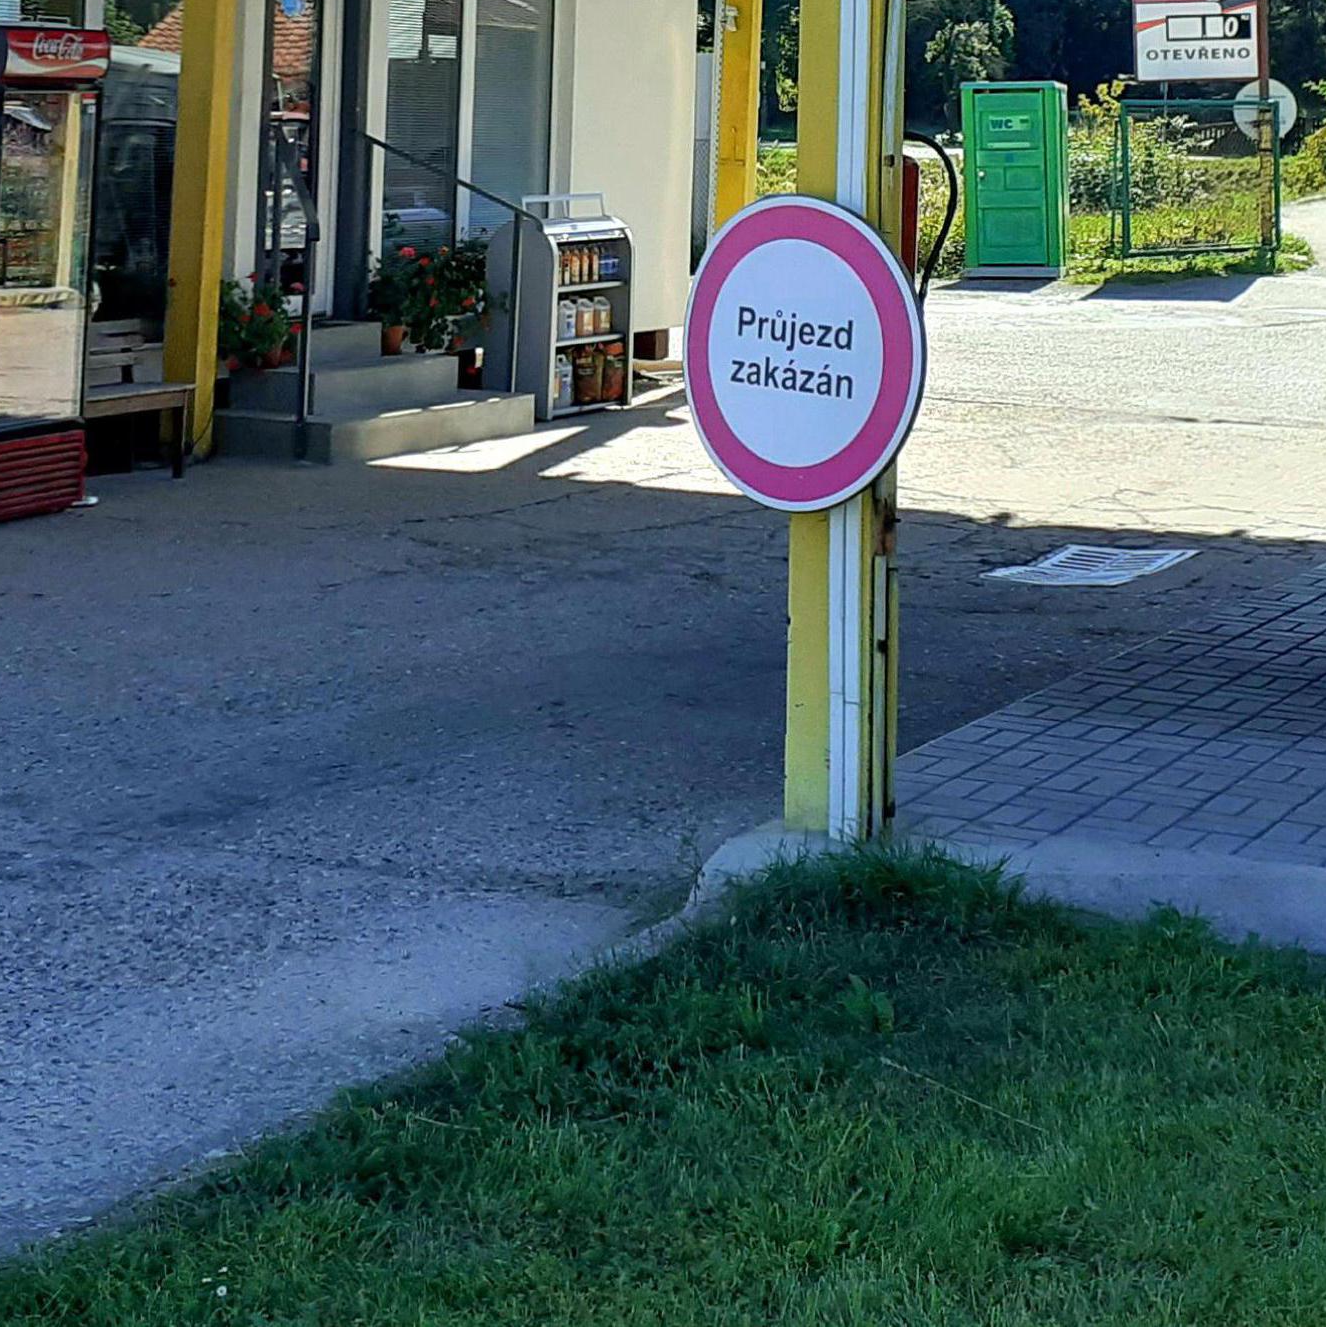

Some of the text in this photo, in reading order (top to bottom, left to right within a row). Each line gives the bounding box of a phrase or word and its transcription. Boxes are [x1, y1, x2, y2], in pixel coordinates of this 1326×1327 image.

[33, 32, 83, 60] Coca-Cola
[1146, 46, 1251, 61] OTEVŘENO
[990, 118, 1013, 130] WC
[737, 306, 854, 352] Průjezd
[730, 356, 854, 400] zakázán
